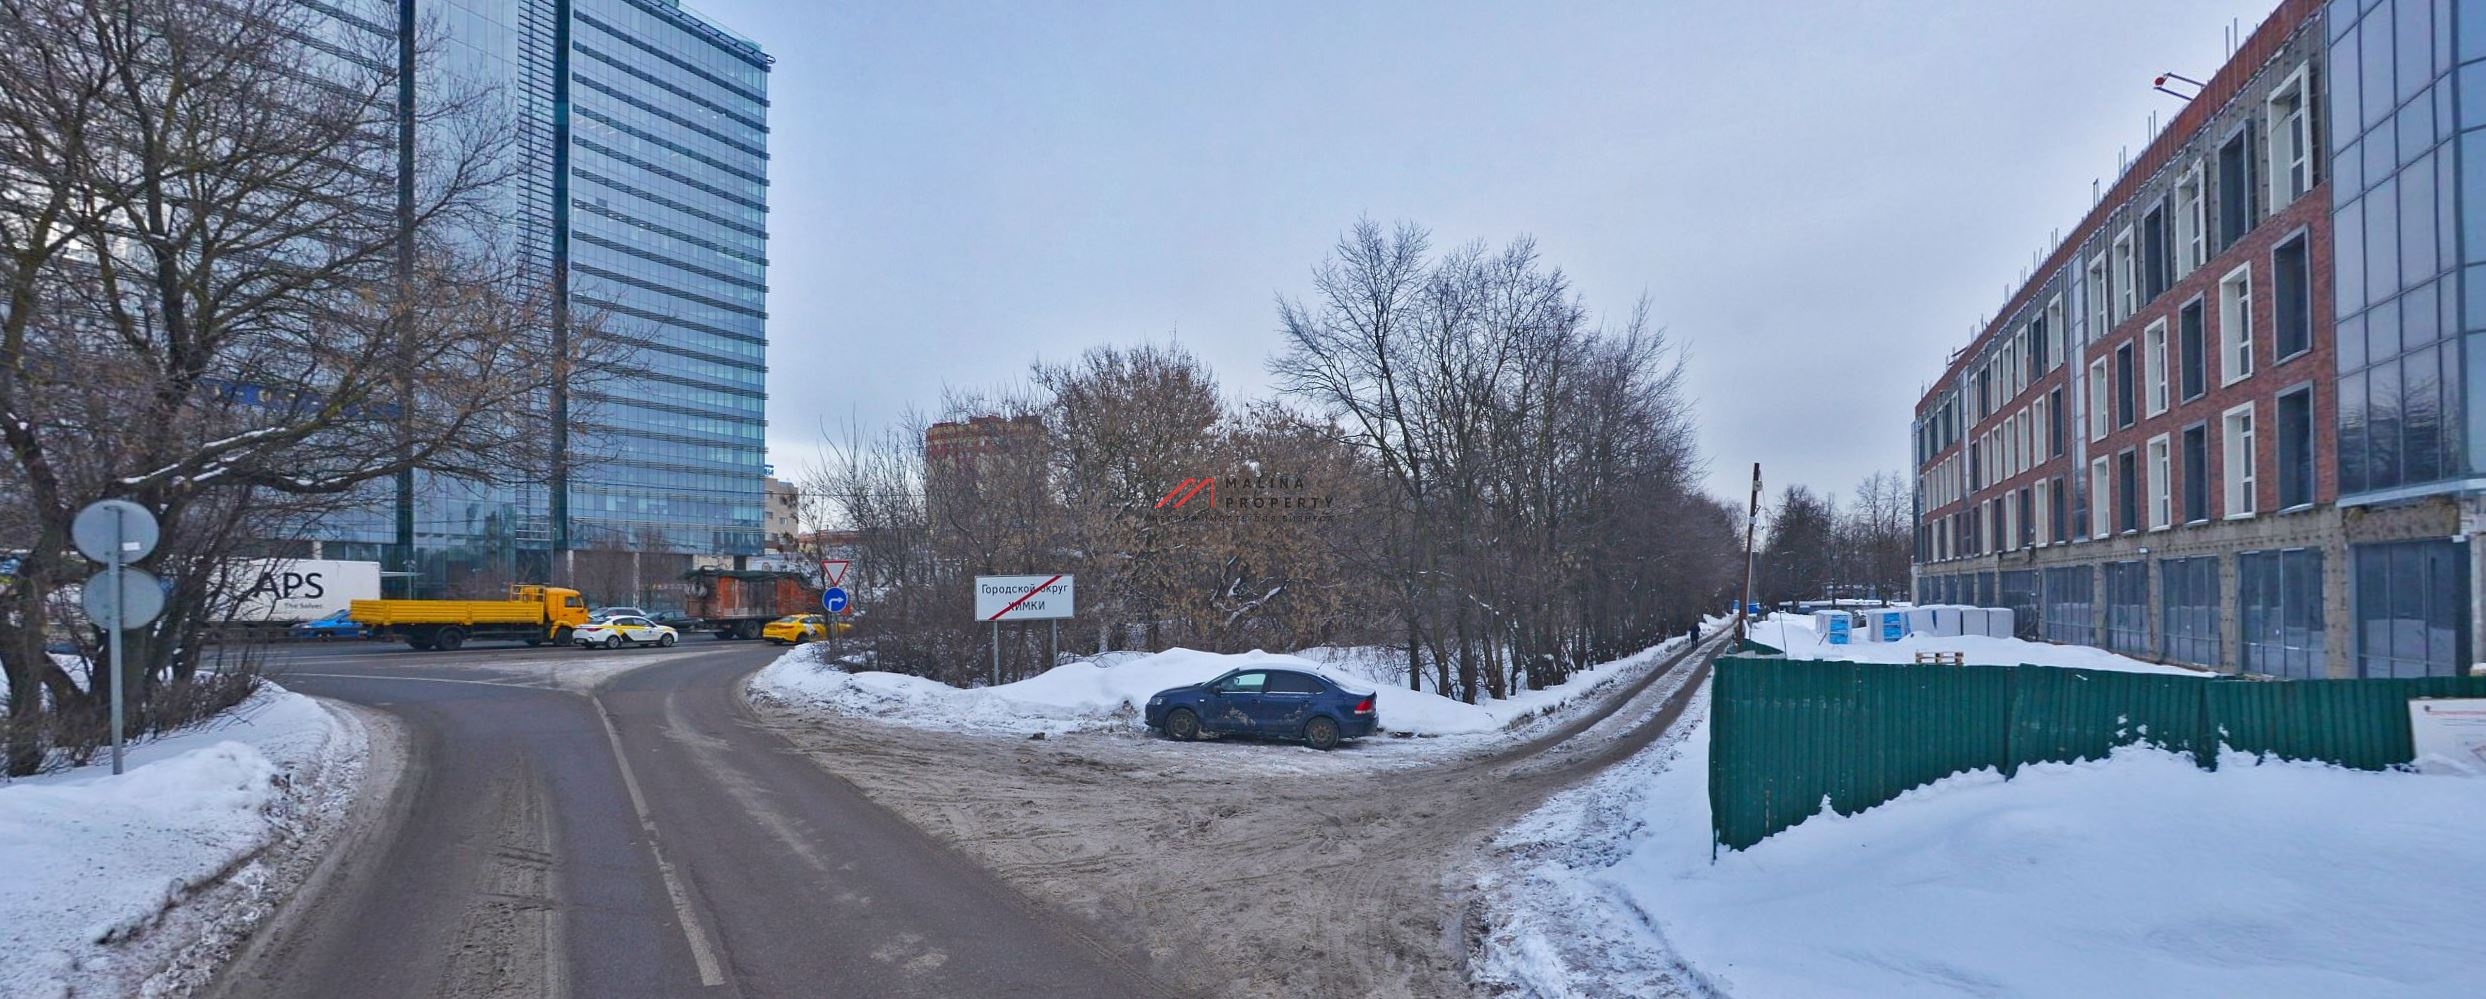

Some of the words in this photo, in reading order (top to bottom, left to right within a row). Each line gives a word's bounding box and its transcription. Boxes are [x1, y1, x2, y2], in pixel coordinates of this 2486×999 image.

[253, 572, 324, 600] APS
[981, 583, 1035, 596] Городской
[1040, 584, 1068, 596] округ
